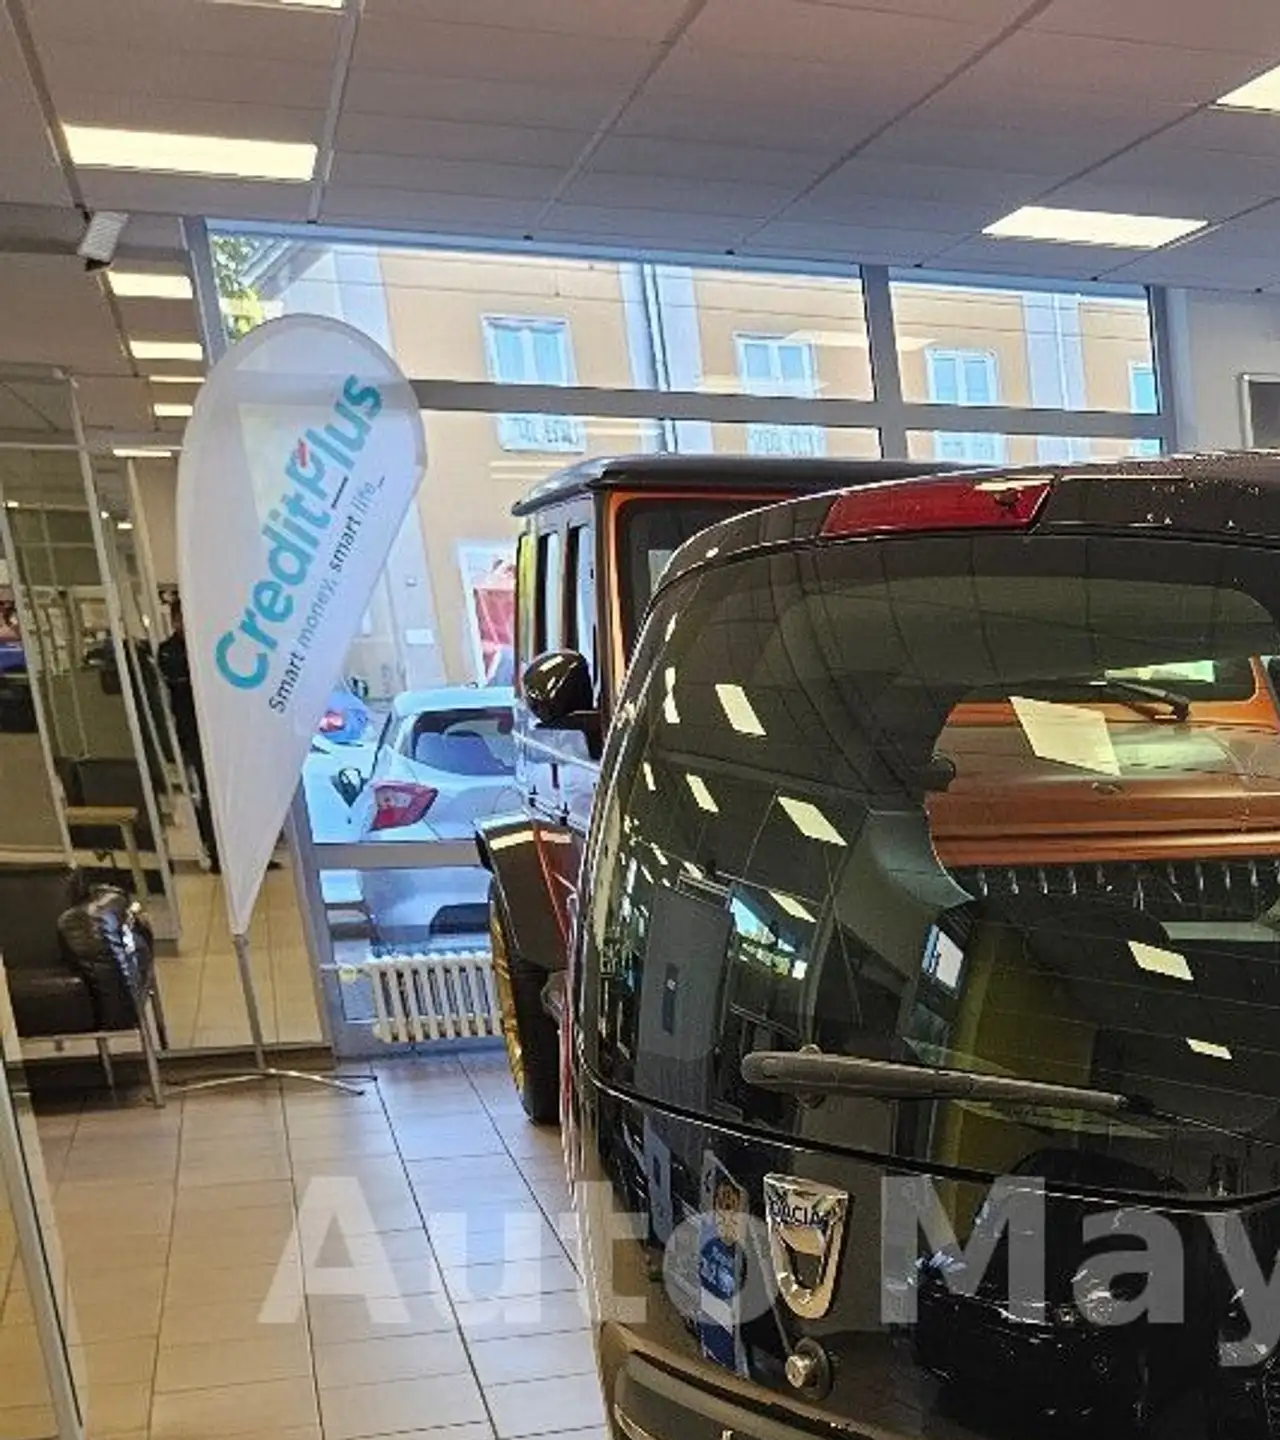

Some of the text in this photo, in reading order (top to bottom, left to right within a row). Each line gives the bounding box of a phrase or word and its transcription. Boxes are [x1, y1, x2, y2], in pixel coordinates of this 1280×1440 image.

[215, 374, 383, 690] CreditPlus
[268, 649, 305, 714] Smart
[298, 576, 339, 650] money,
[329, 515, 361, 574] smart
